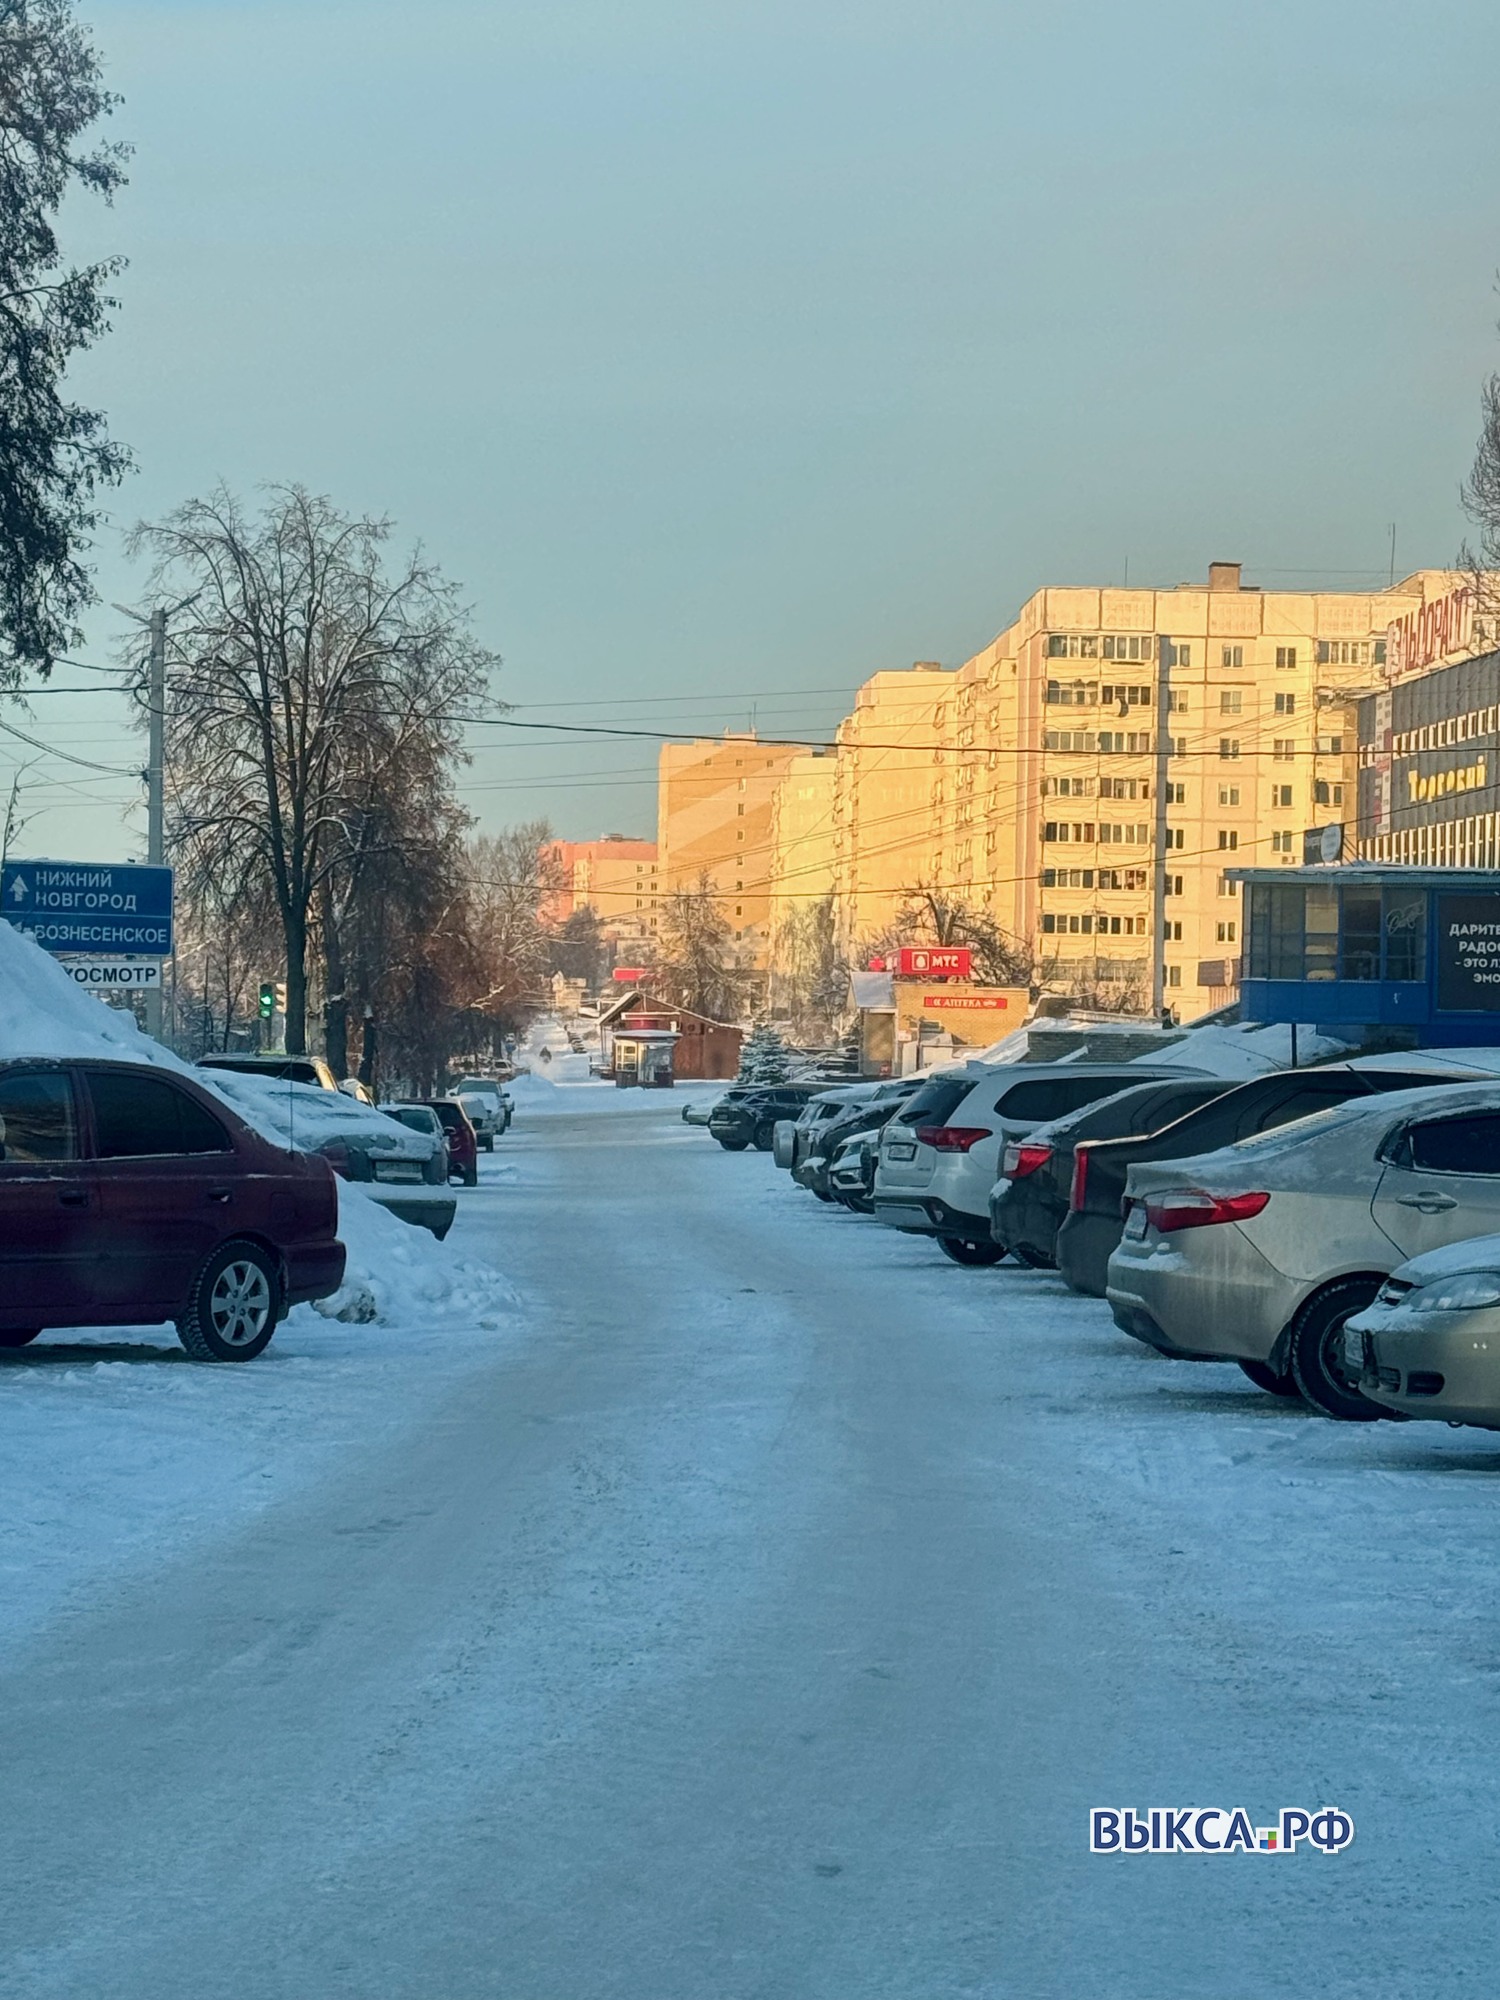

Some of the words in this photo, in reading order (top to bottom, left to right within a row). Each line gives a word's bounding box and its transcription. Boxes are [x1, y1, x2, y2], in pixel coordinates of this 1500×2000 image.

[35, 869, 112, 888] НИЖНИЙ
[35, 892, 137, 912] НОВГОРОД
[34, 924, 167, 943] ВОЗНЕСЕНСКОЕ
[1459, 941, 1500, 954] РАДО
[932, 955, 959, 968] МТС
[1463, 958, 1488, 968] ЭТО
[943, 998, 981, 1007] АПТЕКА
